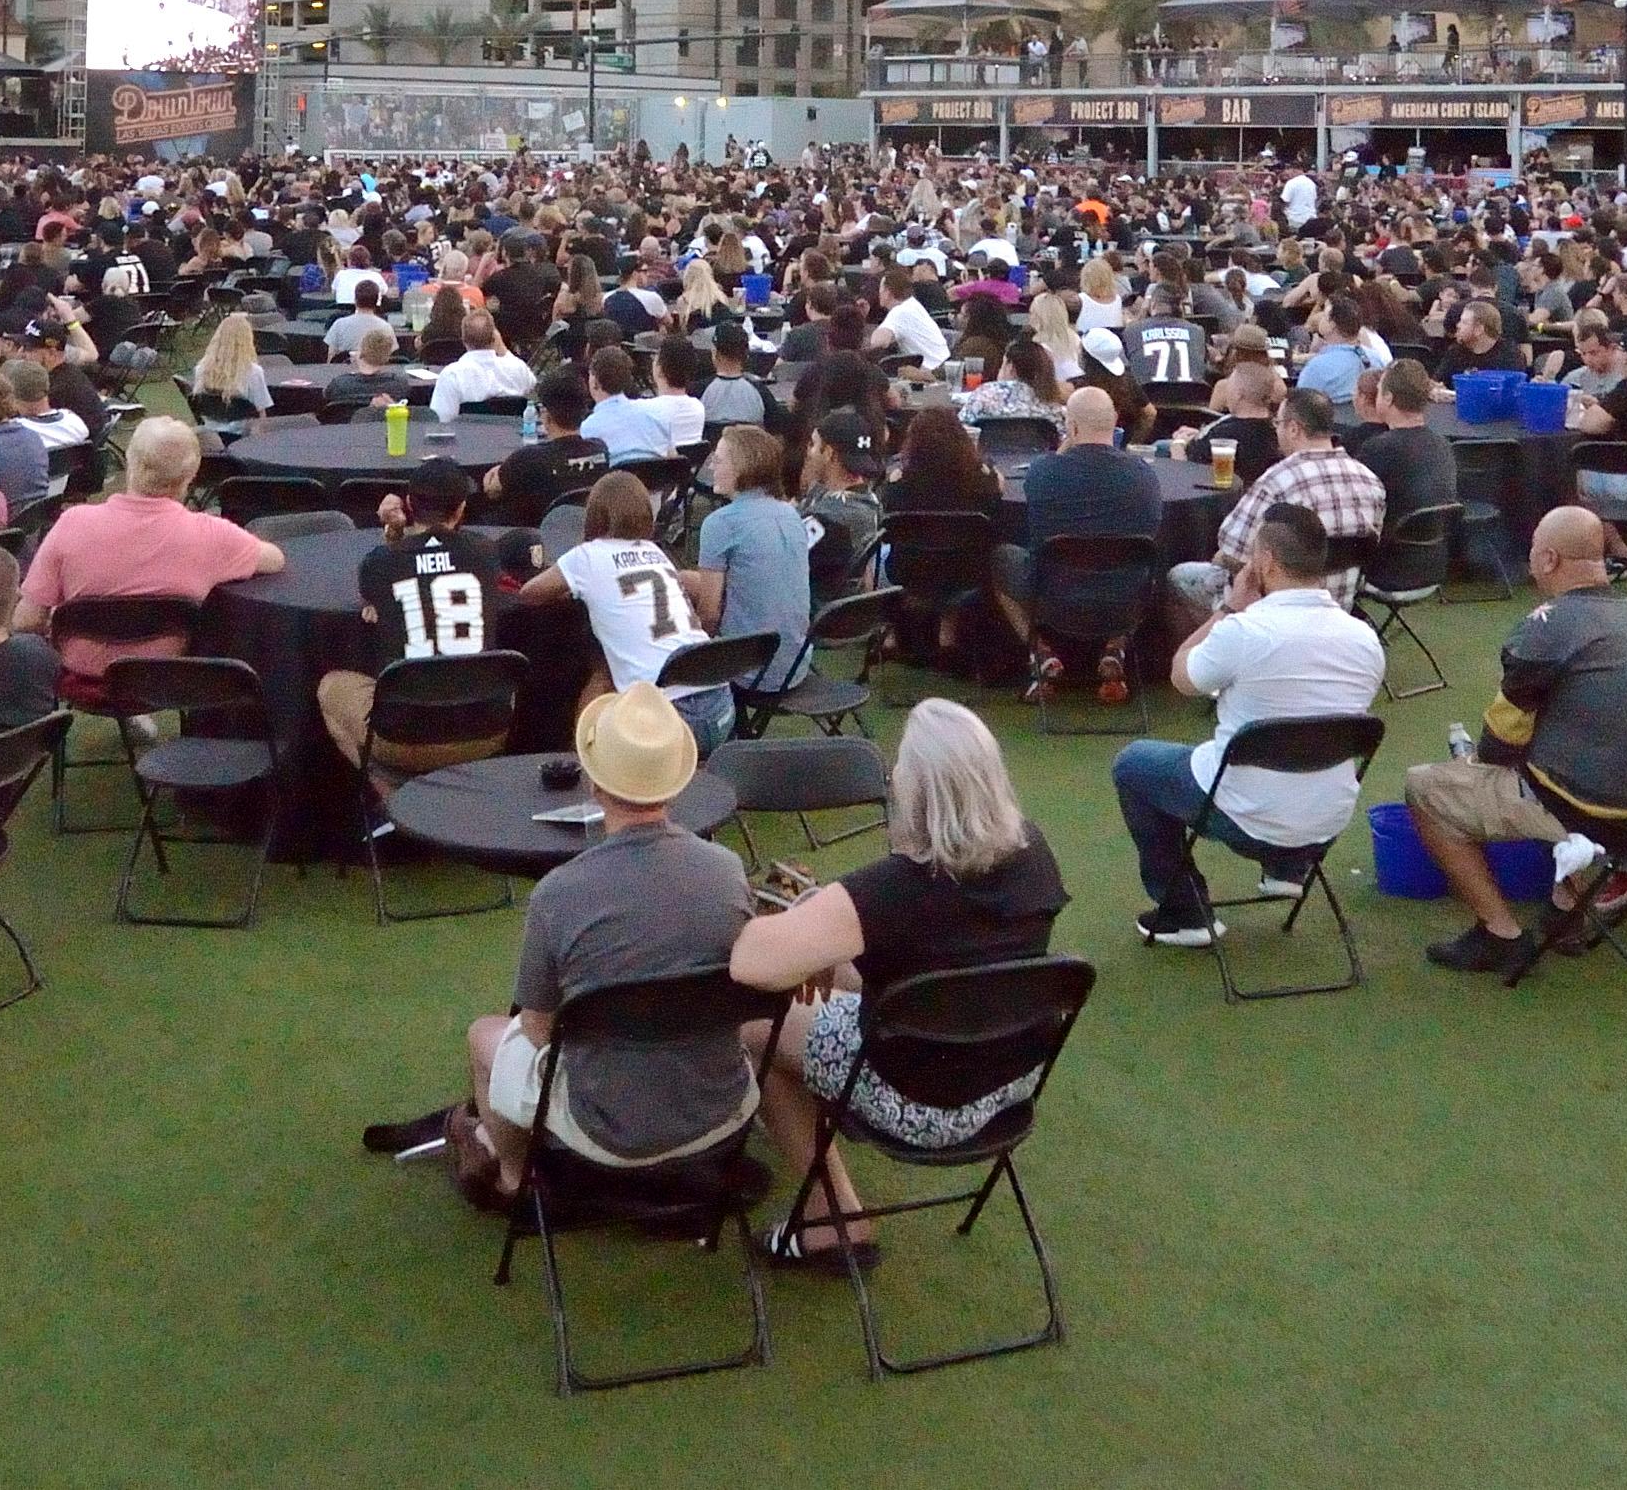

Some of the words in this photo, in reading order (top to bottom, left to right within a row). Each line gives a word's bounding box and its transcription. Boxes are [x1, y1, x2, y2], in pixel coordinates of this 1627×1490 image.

[112, 82, 237, 124] Downtown
[932, 101, 971, 119] PROJECT
[974, 101, 993, 119] BBQ
[1071, 101, 1114, 120] PROJECT
[1117, 101, 1139, 120] BBQ
[1222, 98, 1251, 123] BAR
[1391, 102, 1439, 118] AMERICAN
[1441, 102, 1471, 118] CONEY
[1474, 102, 1509, 118] ISLAND
[1142, 327, 1191, 342] KARLSSON
[1143, 341, 1192, 383] 71
[415, 551, 456, 575] NEAL
[392, 573, 484, 659] 18
